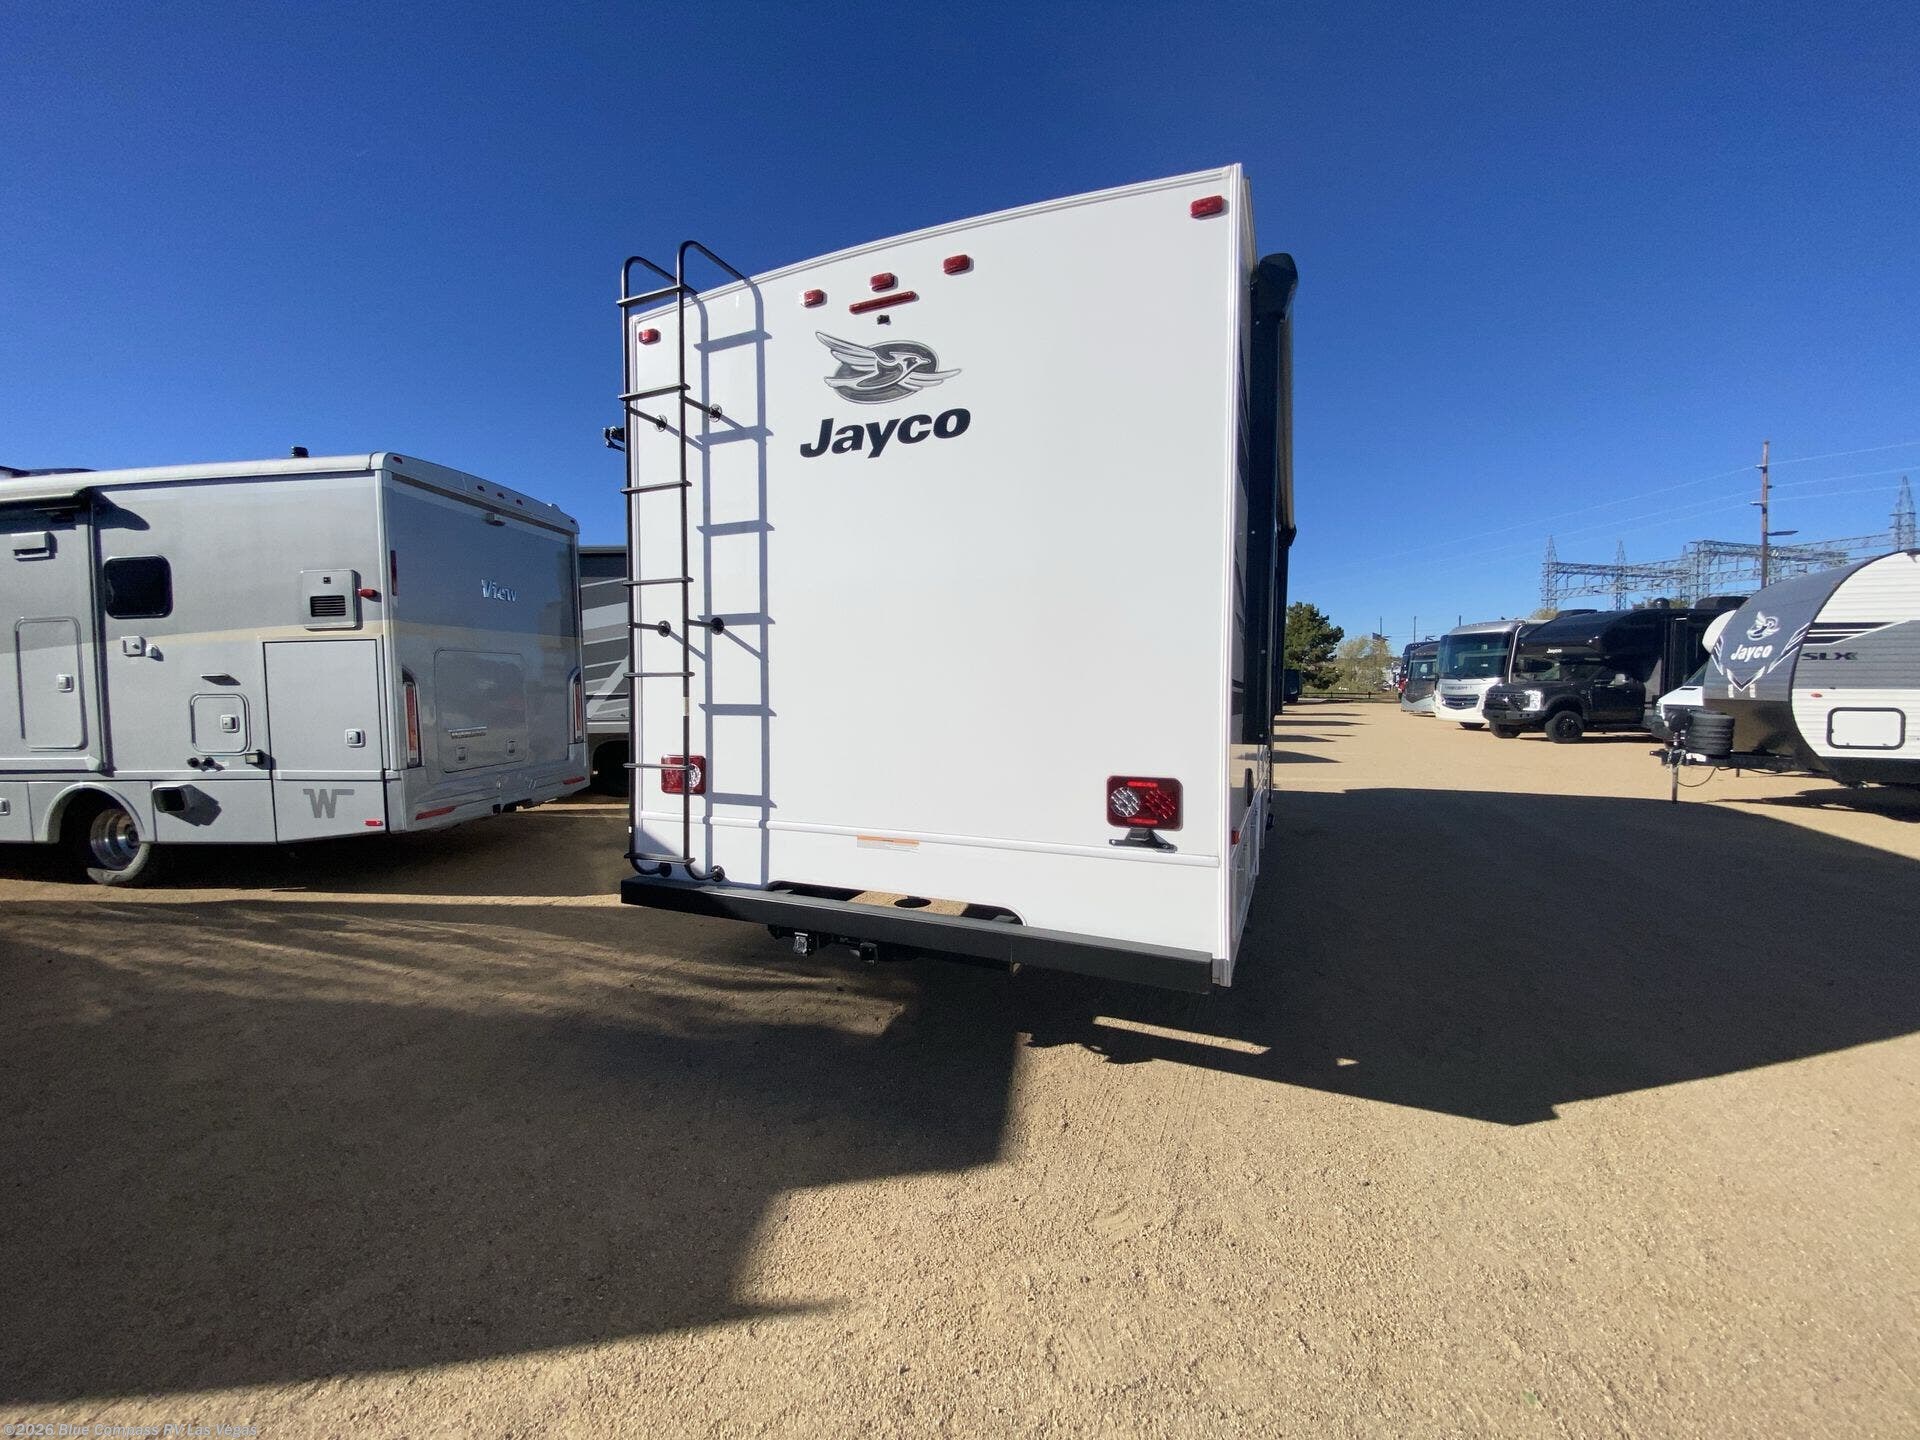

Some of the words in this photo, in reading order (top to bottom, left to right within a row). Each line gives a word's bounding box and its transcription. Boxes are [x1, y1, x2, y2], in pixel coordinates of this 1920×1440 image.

[800, 408, 971, 459] Jayco
[481, 579, 518, 602] View
[1731, 644, 1774, 663] Jayco
[1801, 652, 1857, 661] SLX
